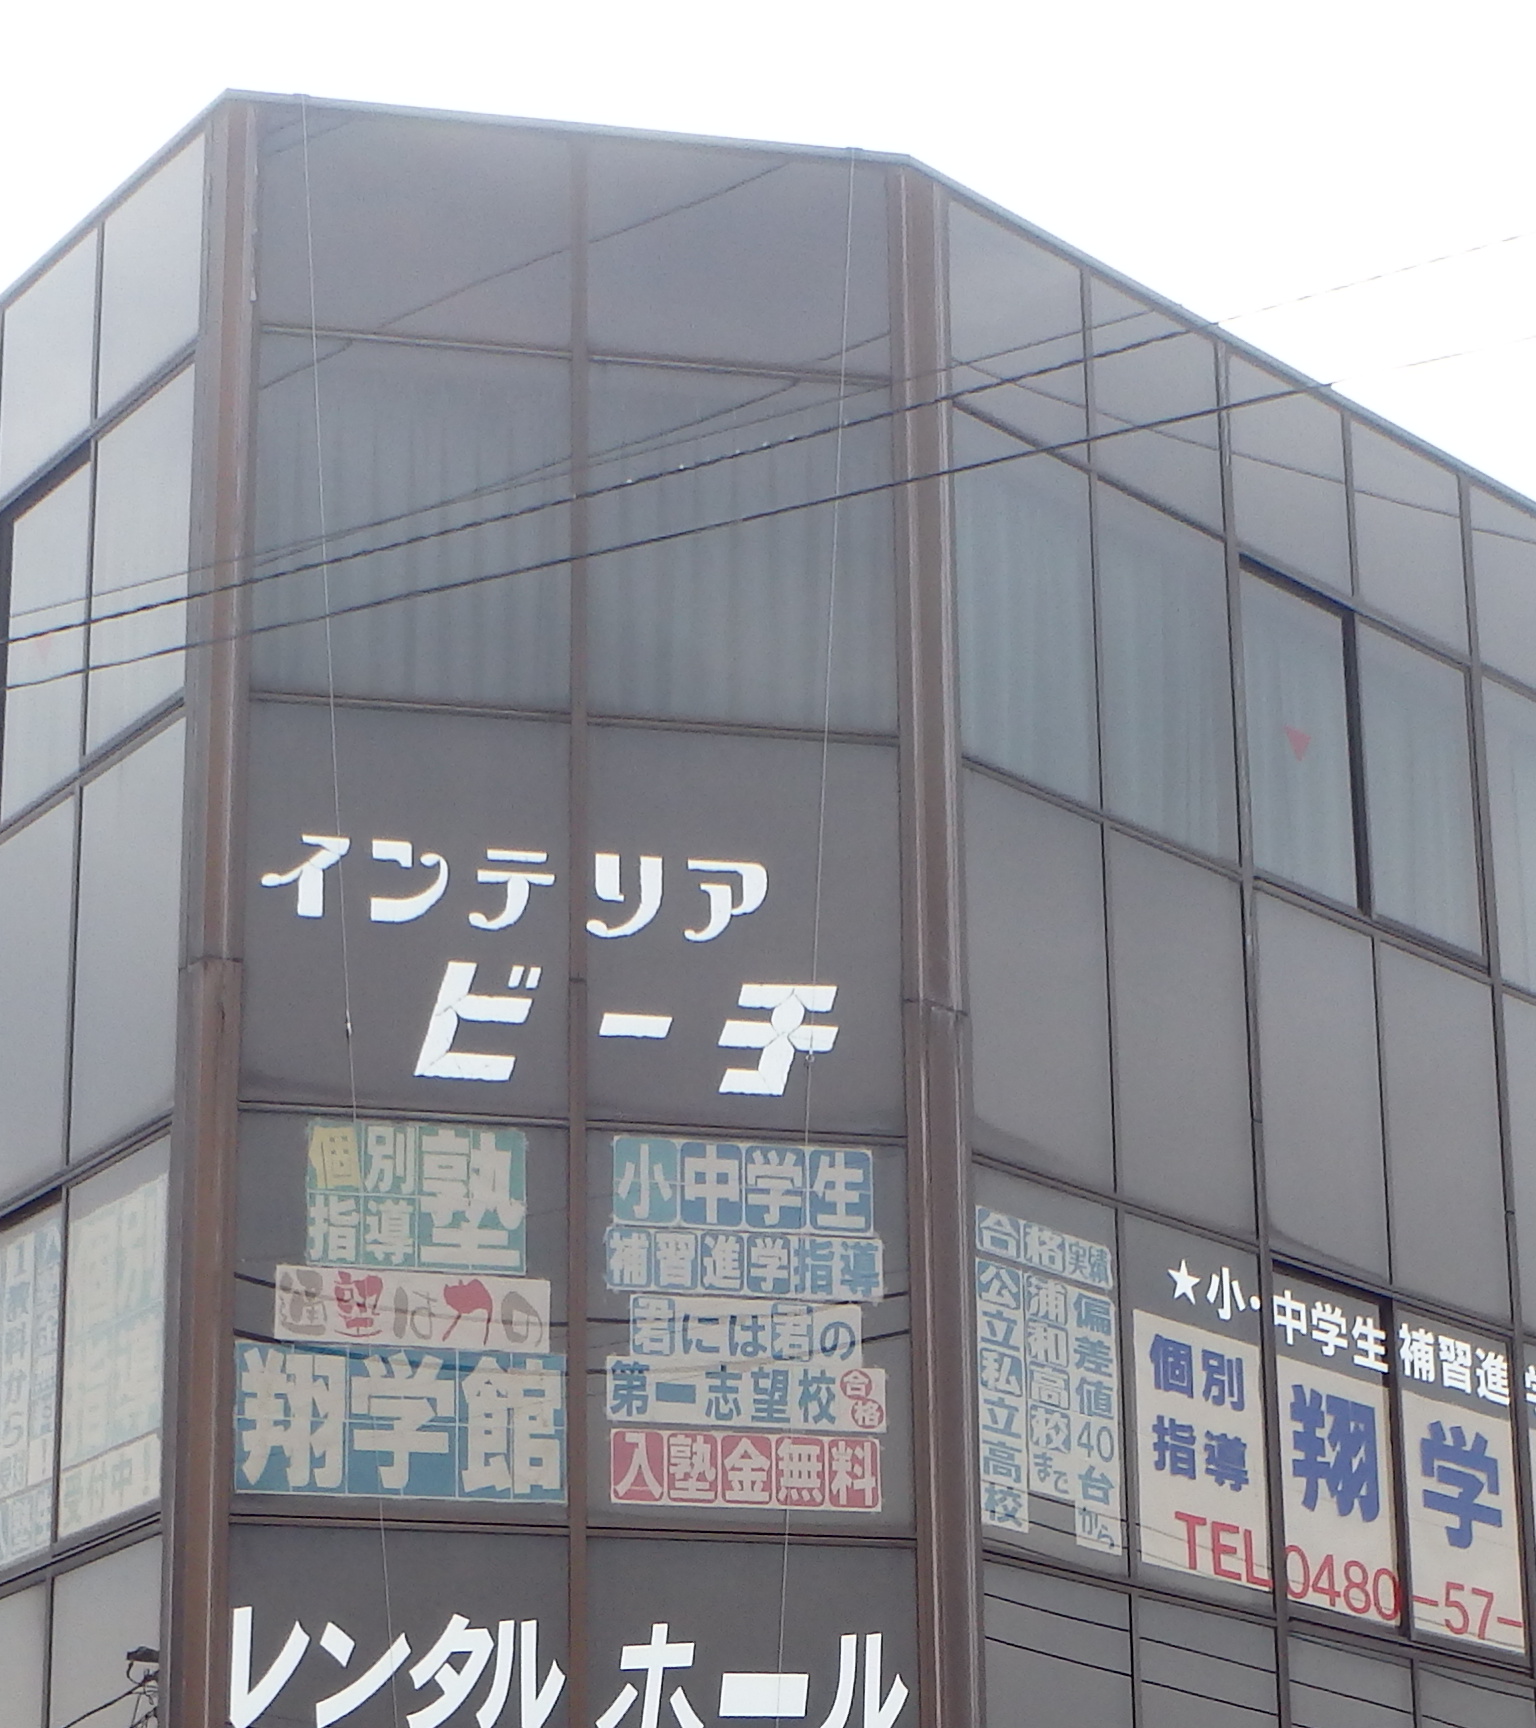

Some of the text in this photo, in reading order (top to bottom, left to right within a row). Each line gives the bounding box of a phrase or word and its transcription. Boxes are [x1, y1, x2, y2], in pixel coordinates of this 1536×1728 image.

[261, 834, 769, 942] インテリア
[414, 961, 839, 1096] ビーチ
[616, 1143, 866, 1229] 小中学生
[306, 1195, 416, 1264] 指導
[609, 1231, 879, 1298] 補習進学指導
[631, 1297, 857, 1362] 君には君の
[1150, 1333, 1245, 1412] 個別
[236, 1347, 563, 1495] 翔学館
[1151, 1417, 1250, 1493] 指導
[614, 1432, 877, 1506] 入塾金無料
